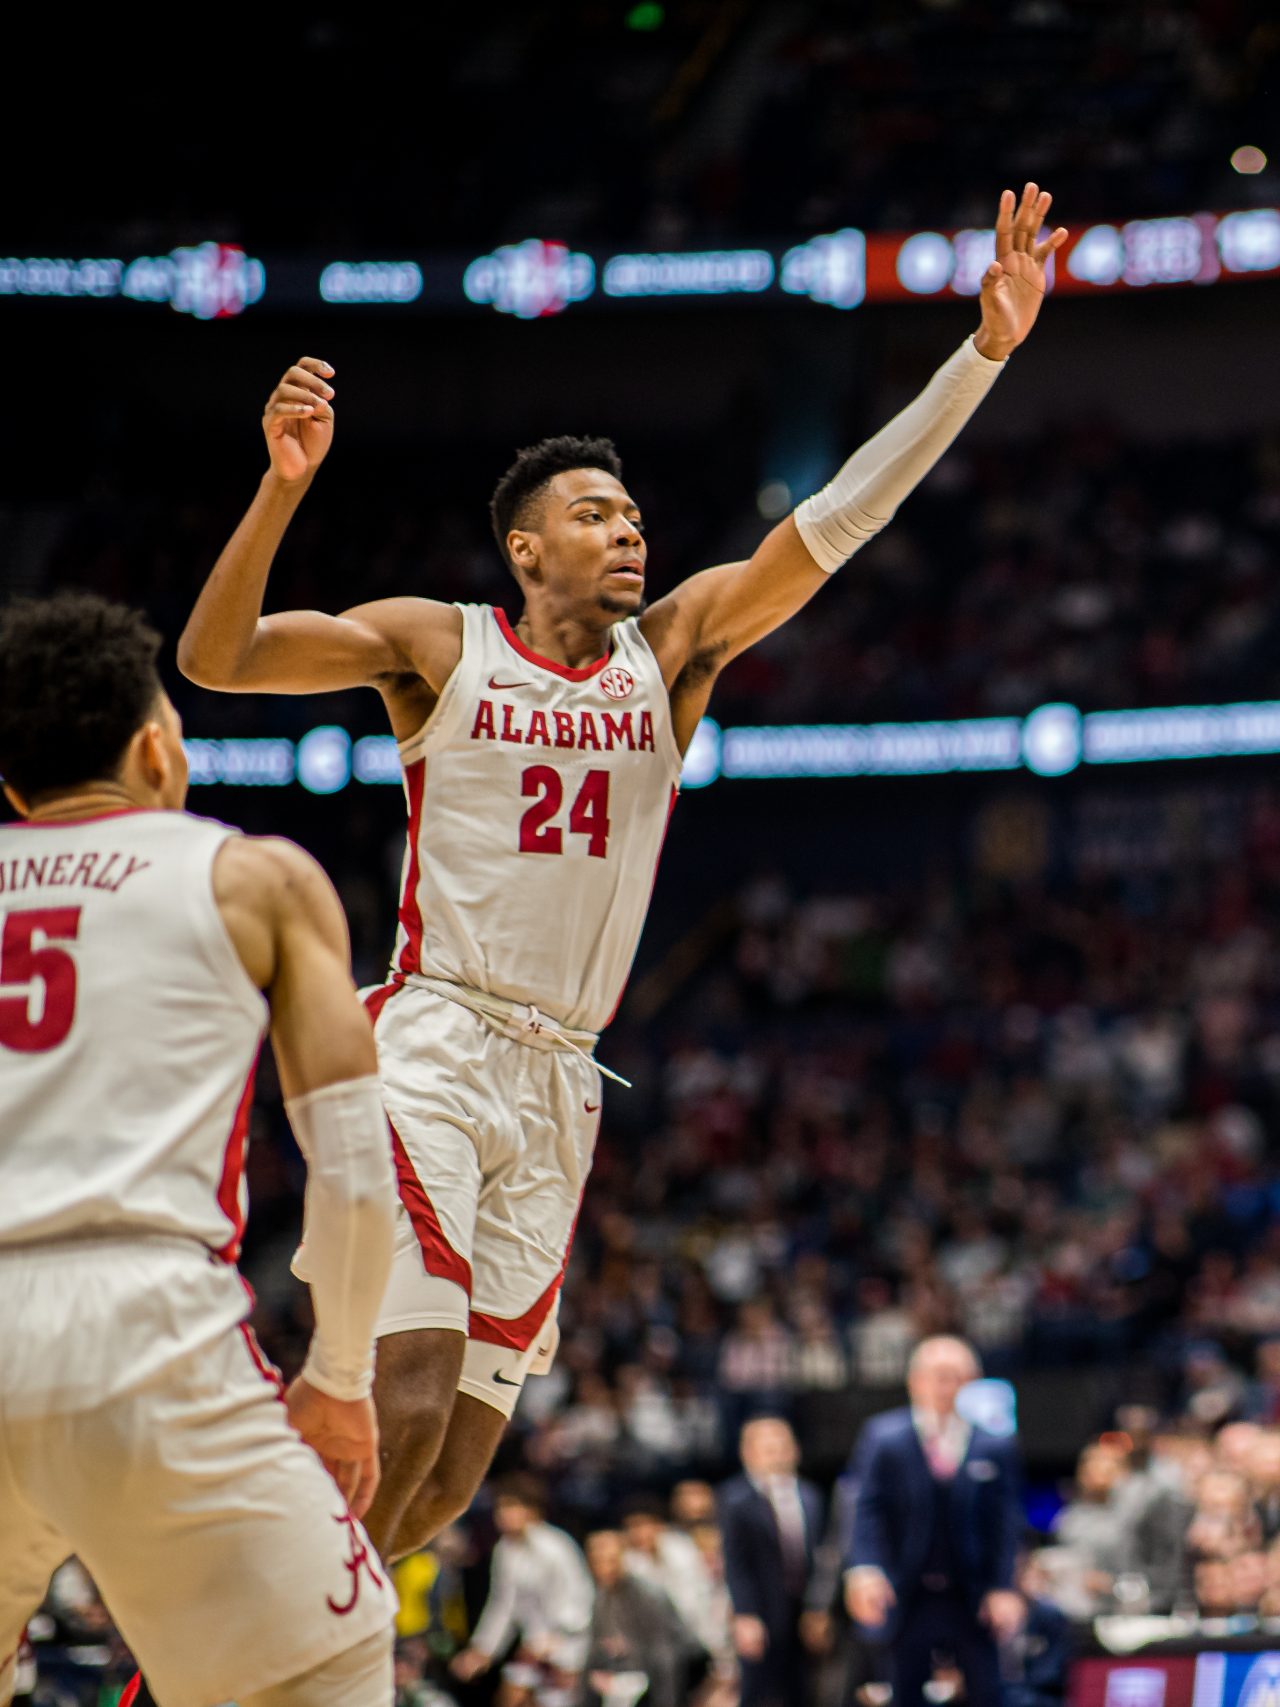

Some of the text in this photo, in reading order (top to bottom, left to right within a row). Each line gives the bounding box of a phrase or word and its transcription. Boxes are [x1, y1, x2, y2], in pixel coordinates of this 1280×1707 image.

[599, 668, 634, 699] SEC
[470, 699, 656, 753] ALABAMA
[518, 764, 611, 860] 24
[0, 905, 83, 1055] 5
